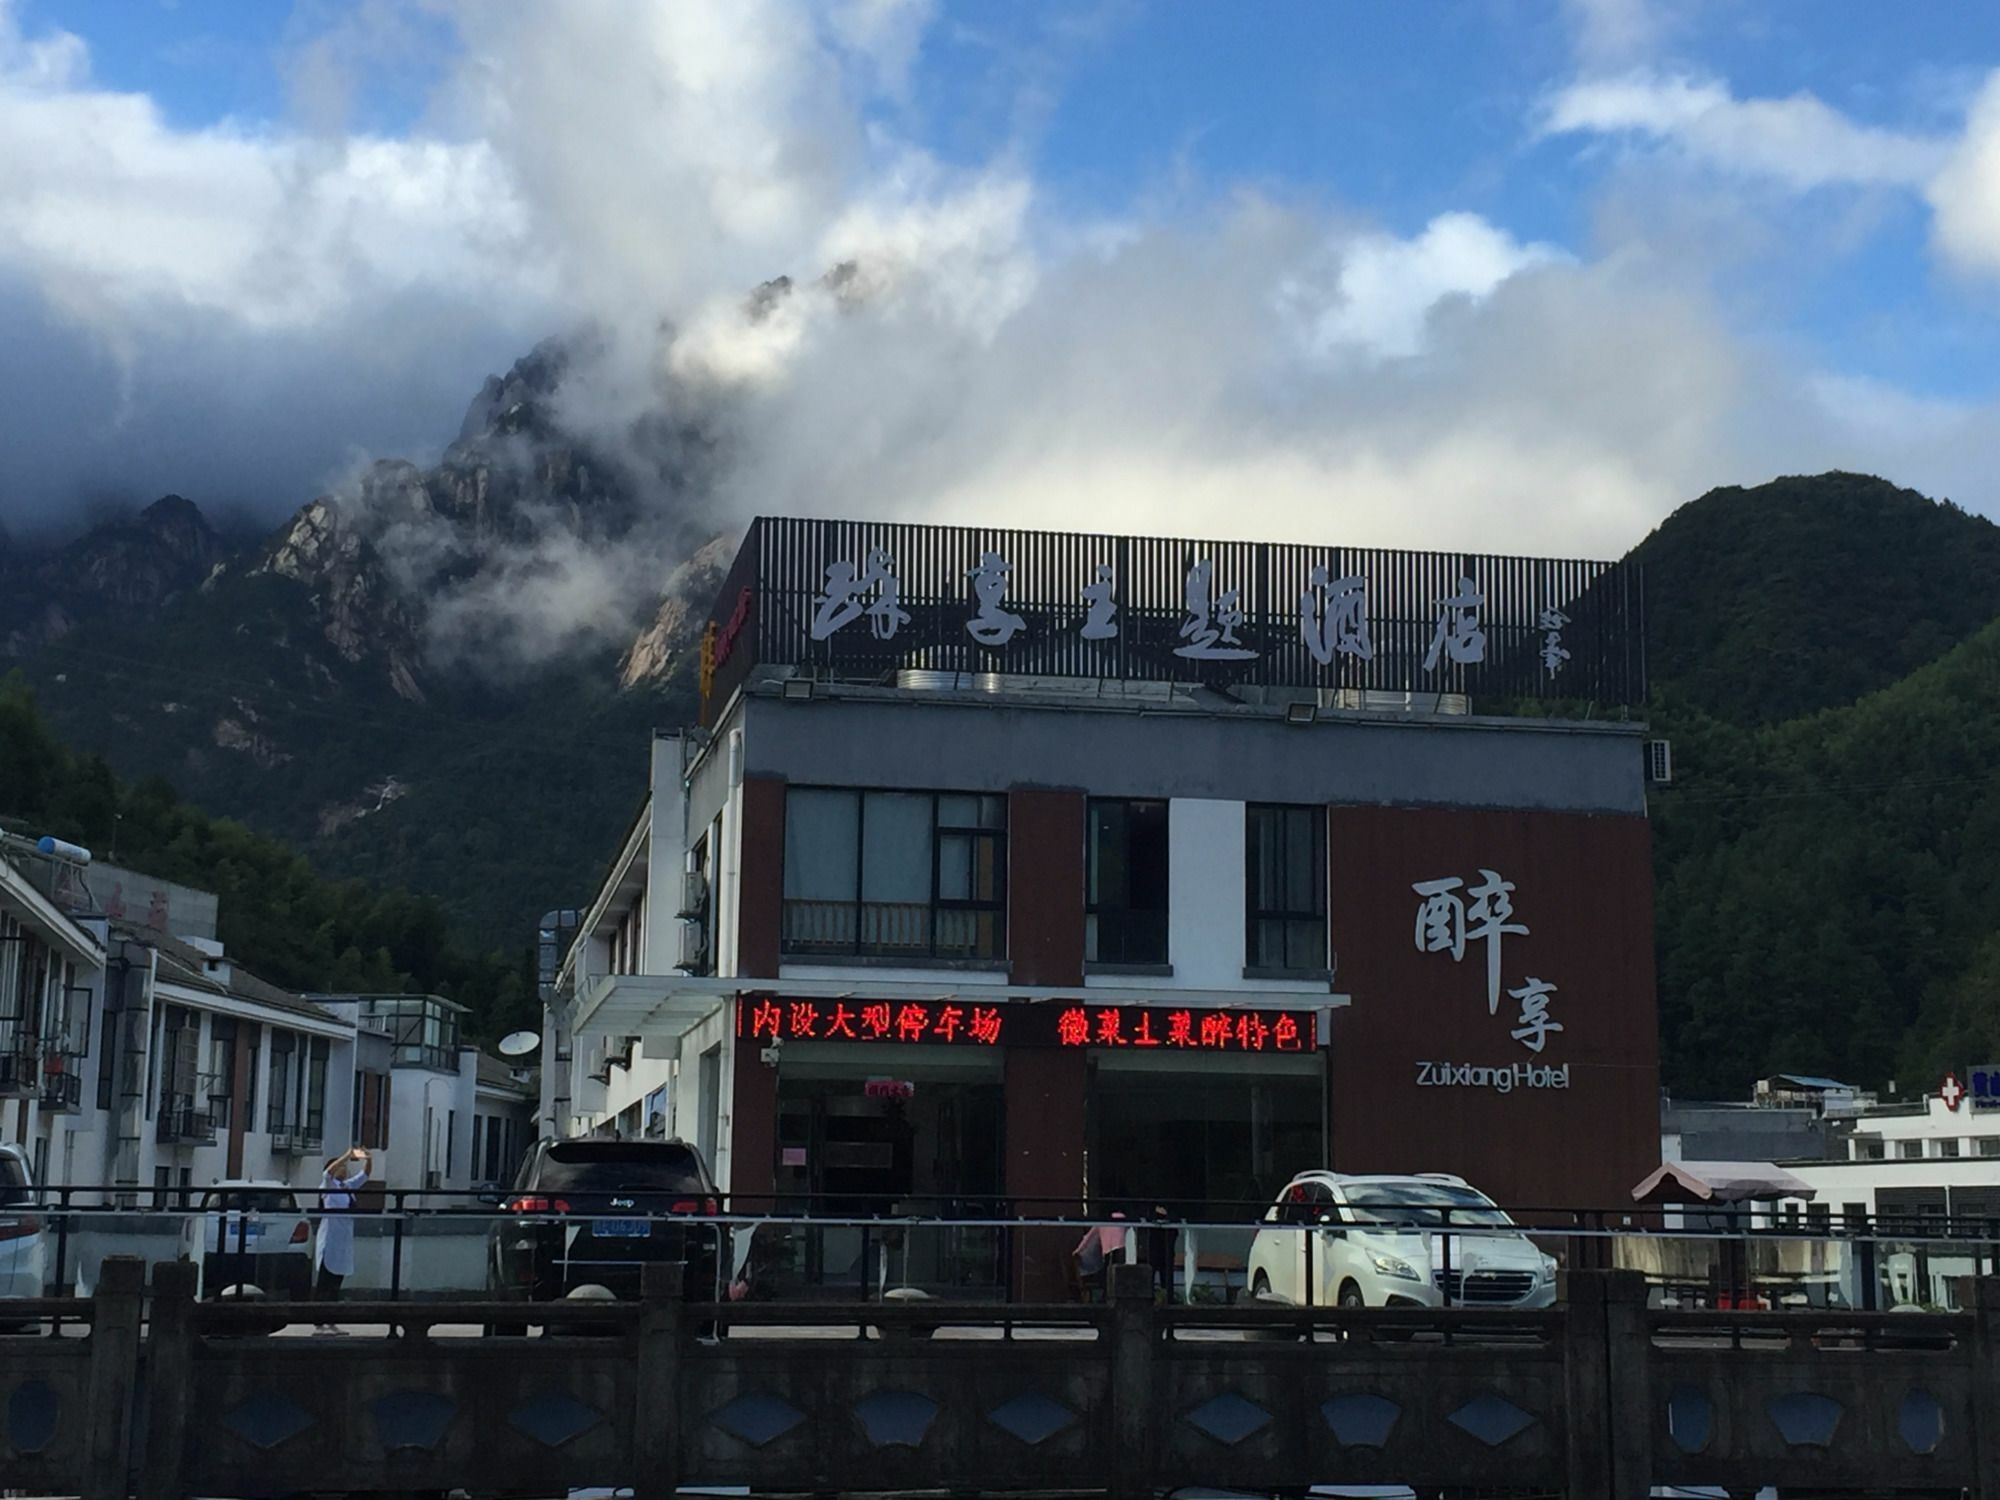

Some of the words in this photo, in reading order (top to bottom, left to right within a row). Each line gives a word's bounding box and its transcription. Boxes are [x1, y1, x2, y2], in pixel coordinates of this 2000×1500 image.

[752, 1000, 1003, 1045] 内设大型停车场
[610, 1198, 634, 1208] Jeep
